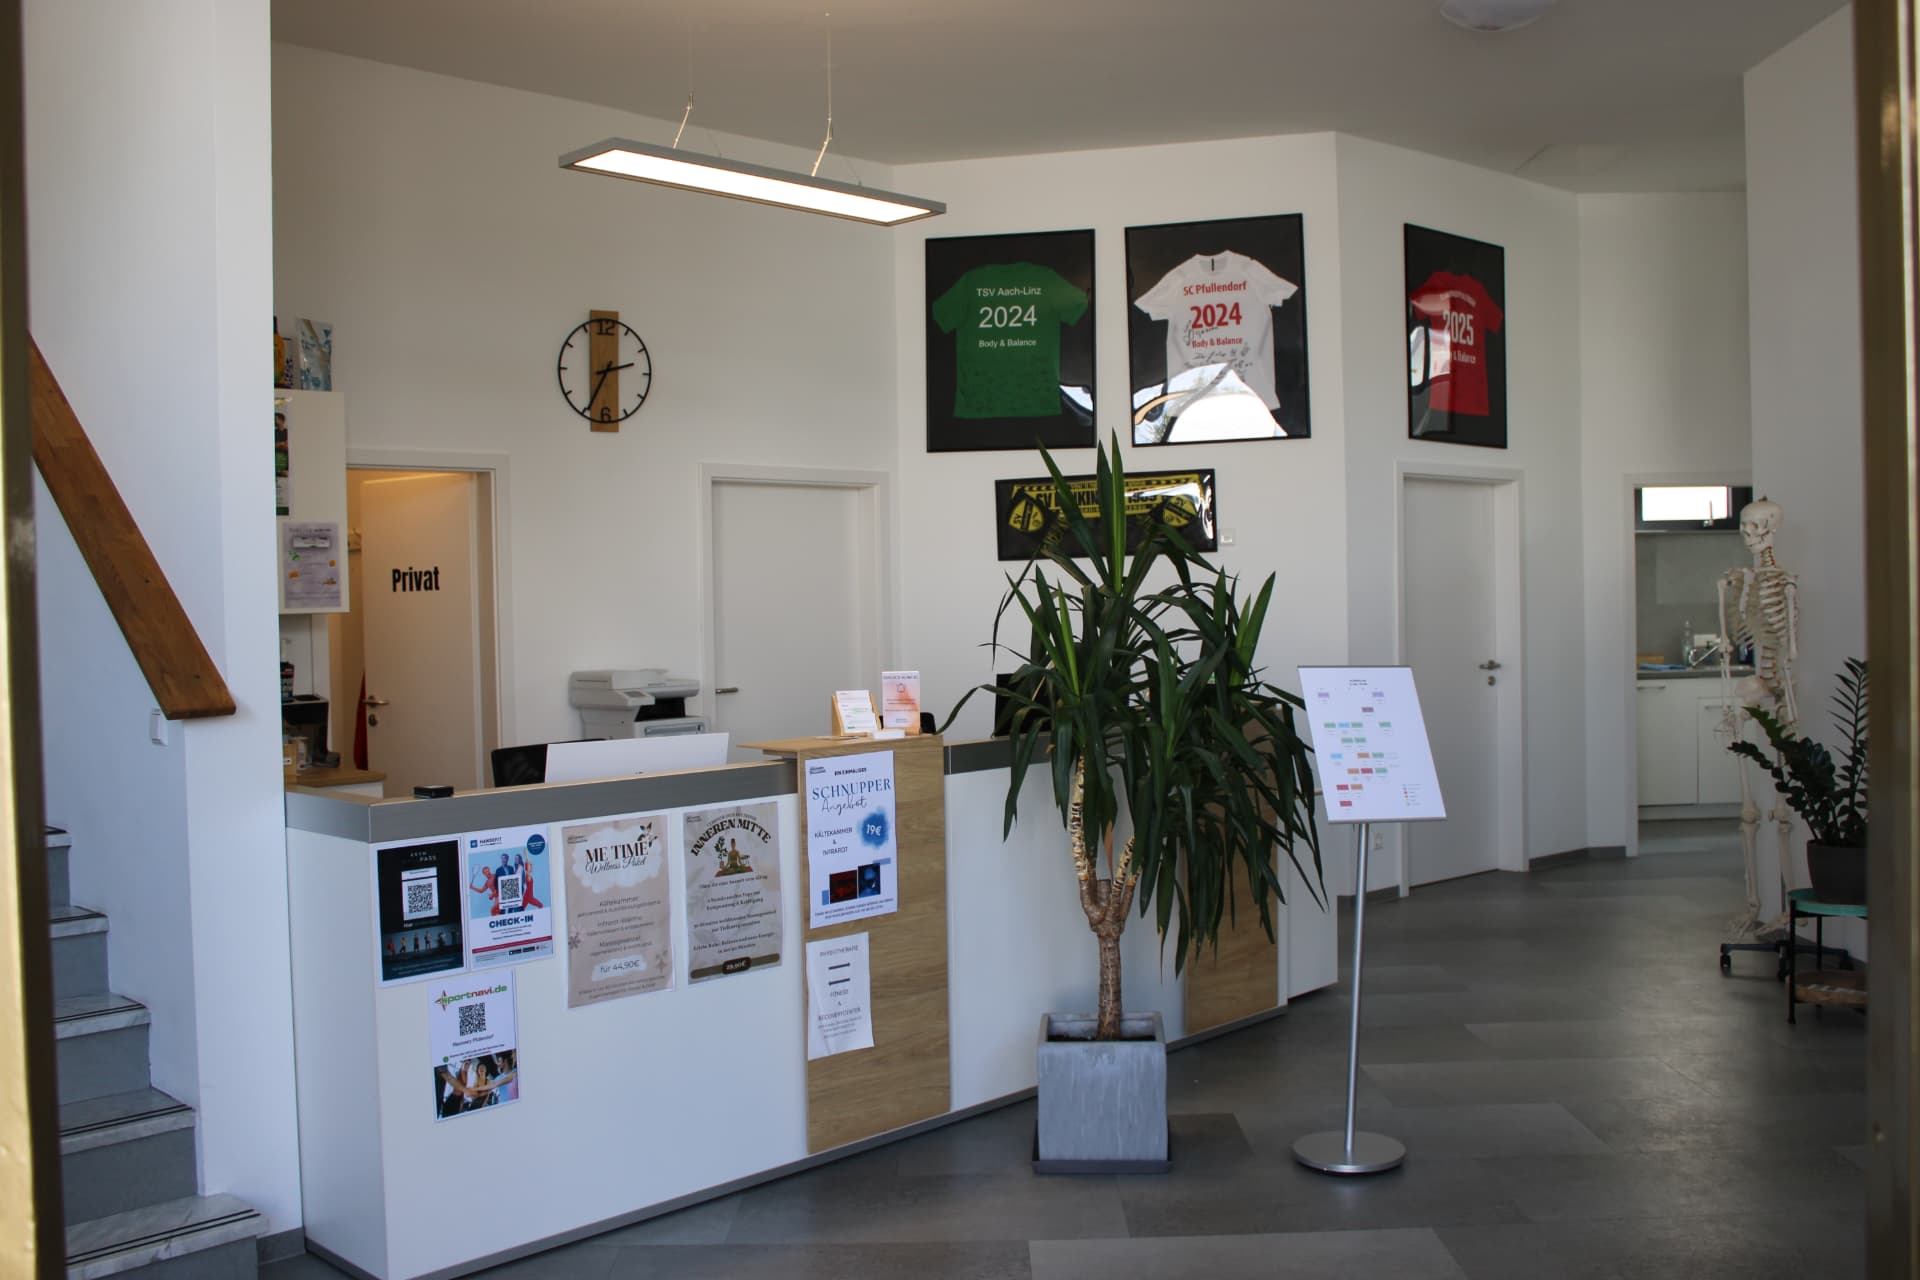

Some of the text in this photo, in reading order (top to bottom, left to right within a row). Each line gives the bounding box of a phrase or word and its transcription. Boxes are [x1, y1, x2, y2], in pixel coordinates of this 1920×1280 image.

[976, 286, 1042, 297] TSV Aach-Linz
[1183, 280, 1247, 296] SC Pfullendorf
[979, 304, 1038, 328] 2024
[1190, 302, 1242, 329] 2024
[596, 319, 616, 336] 12
[1442, 309, 1474, 346] 2025
[978, 338, 1037, 349] Body & Balance
[1192, 340, 1208, 349] Body
[1216, 337, 1243, 346] Balance
[600, 406, 611, 423] 6
[391, 566, 440, 592] Privat
[812, 778, 891, 801] SCHNUPPER
[821, 795, 868, 816] Angebot
[690, 818, 771, 857] INNEREN MITTE
[866, 824, 881, 836] 19€
[586, 841, 648, 863] ME TIME
[585, 859, 621, 874] Wellness
[489, 914, 534, 929] CHECK-IN
[440, 985, 508, 1005] sportnavi.de
